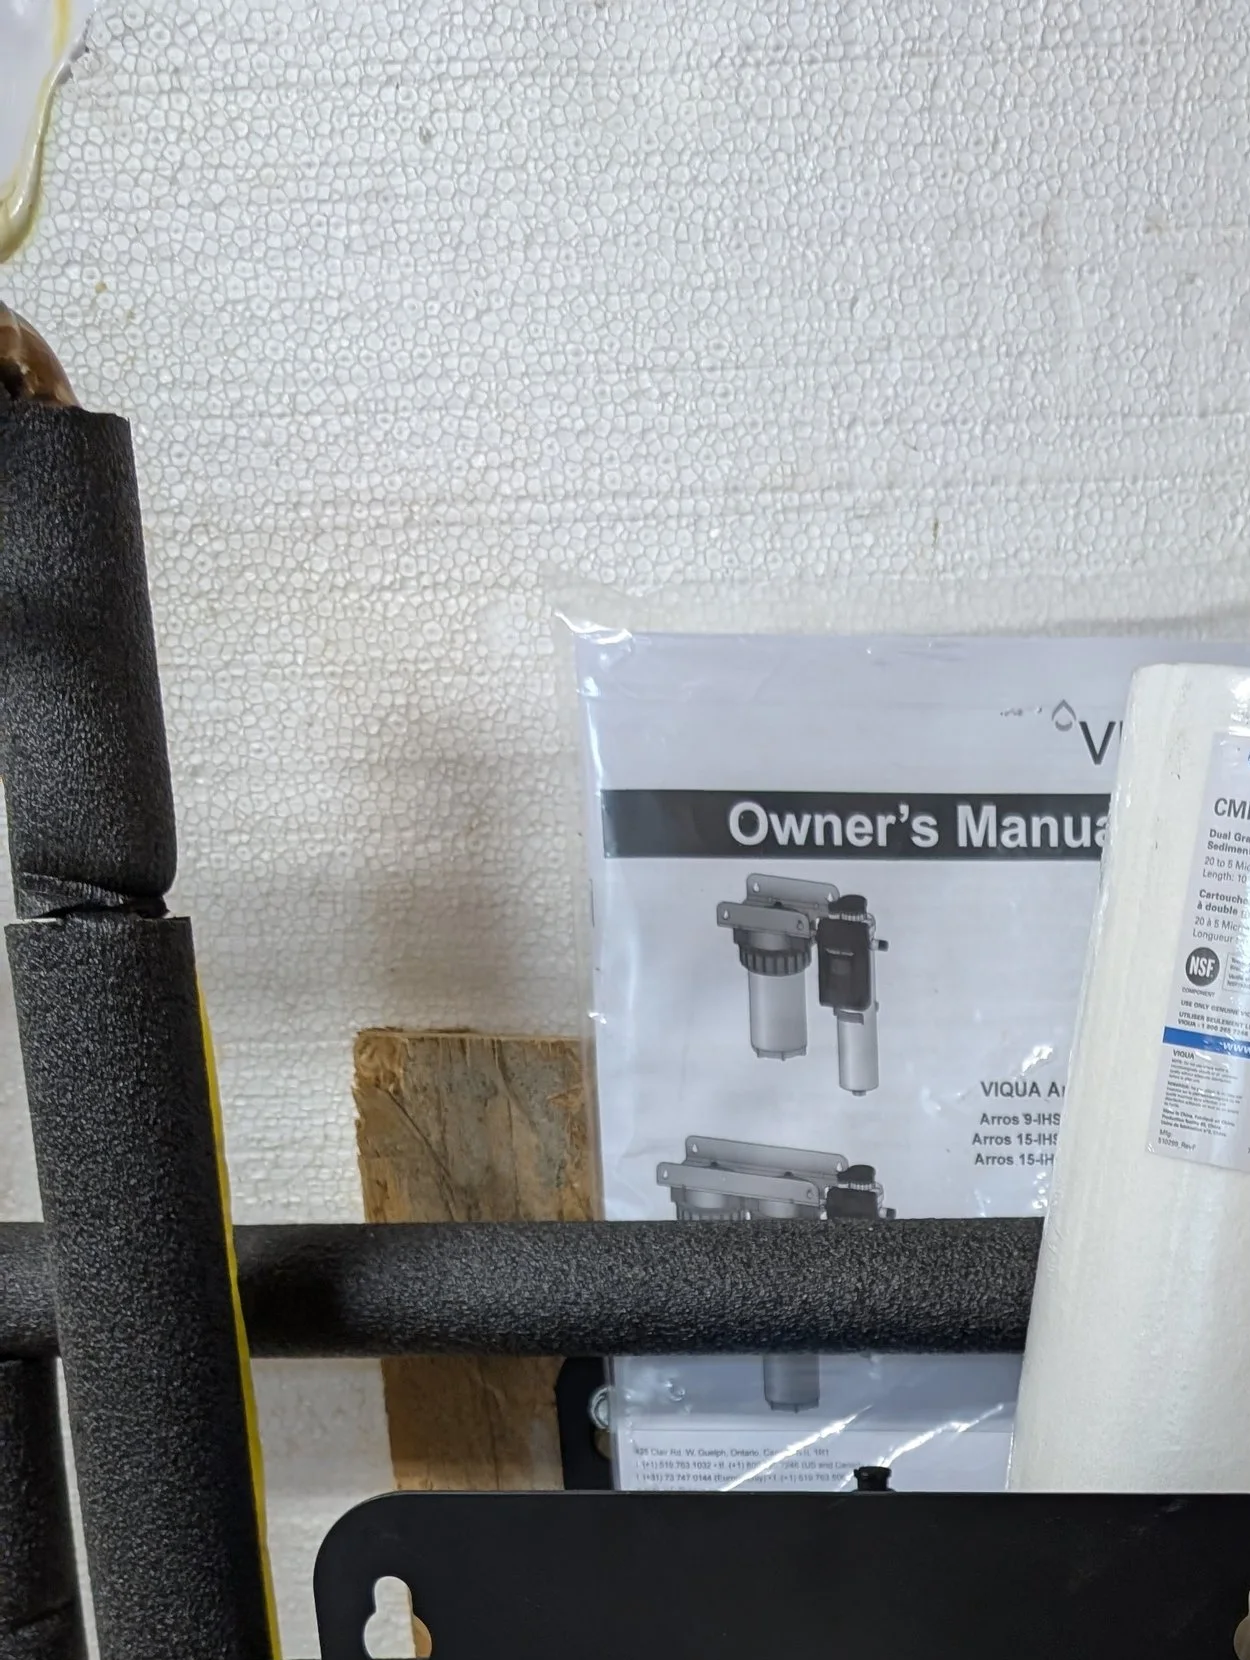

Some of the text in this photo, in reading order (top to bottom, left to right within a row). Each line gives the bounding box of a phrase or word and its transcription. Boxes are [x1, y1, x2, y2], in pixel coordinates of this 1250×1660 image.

[1209, 829, 1231, 840] Dual
[1204, 856, 1233, 869] 20 to 5
[1203, 869, 1234, 882] Length:
[1199, 889, 1248, 905] Cartouche
[1205, 903, 1238, 916] double
[1195, 916, 1205, 925] 20
[1214, 918, 1219, 928] 5
[1193, 929, 1233, 943] Longueur
[1188, 958, 1215, 977] NSF
[1181, 986, 1216, 998] COMPONENT
[1194, 1002, 1209, 1010] ONLY
[1173, 1049, 1194, 1060] VIQUA
[981, 1081, 1041, 1097] VIQUA
[980, 1113, 1060, 1126] Arros 9-IHS
[972, 1133, 1012, 1146] Arros
[974, 1153, 1014, 1166] Arros
